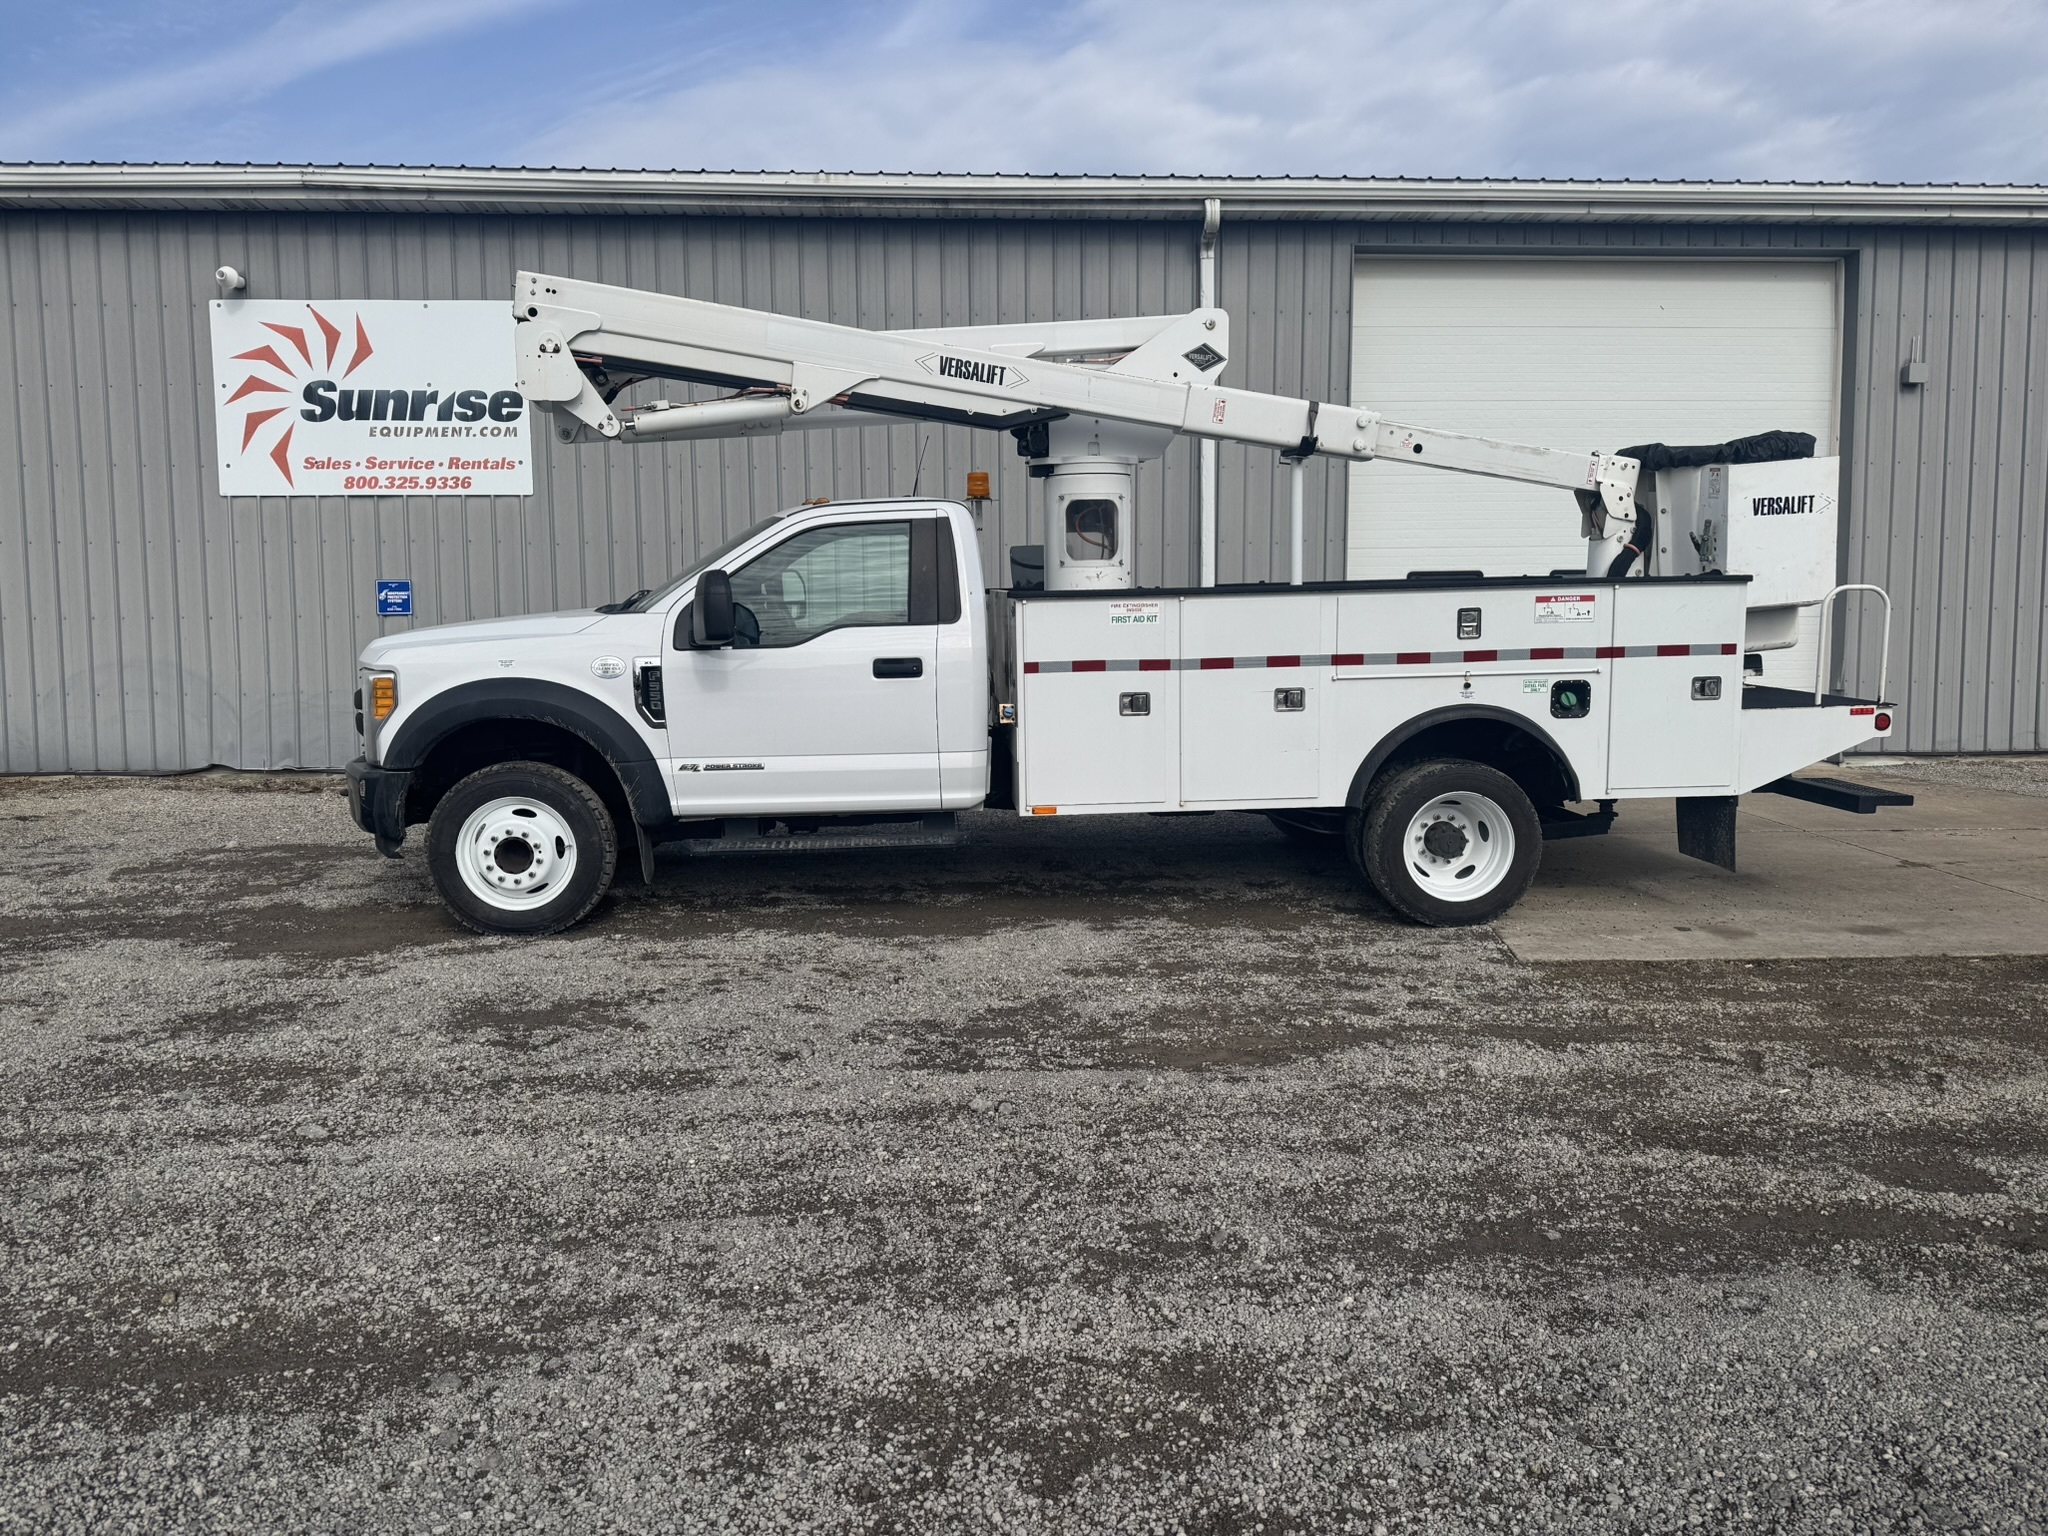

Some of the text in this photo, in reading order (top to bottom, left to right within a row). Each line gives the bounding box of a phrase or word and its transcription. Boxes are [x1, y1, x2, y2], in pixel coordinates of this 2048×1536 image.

[1188, 353, 1213, 361] VERSALIFT
[939, 355, 1007, 386] VERSALIFT
[300, 380, 523, 422] Sunrise
[369, 426, 518, 438] EQUIPMENT.COM
[303, 456, 516, 470] Sales Service Rentals
[343, 476, 473, 490] 800.325.9336
[1752, 495, 1815, 516] VERSALIFT
[1111, 614, 1158, 624] FIRST AID KIT
